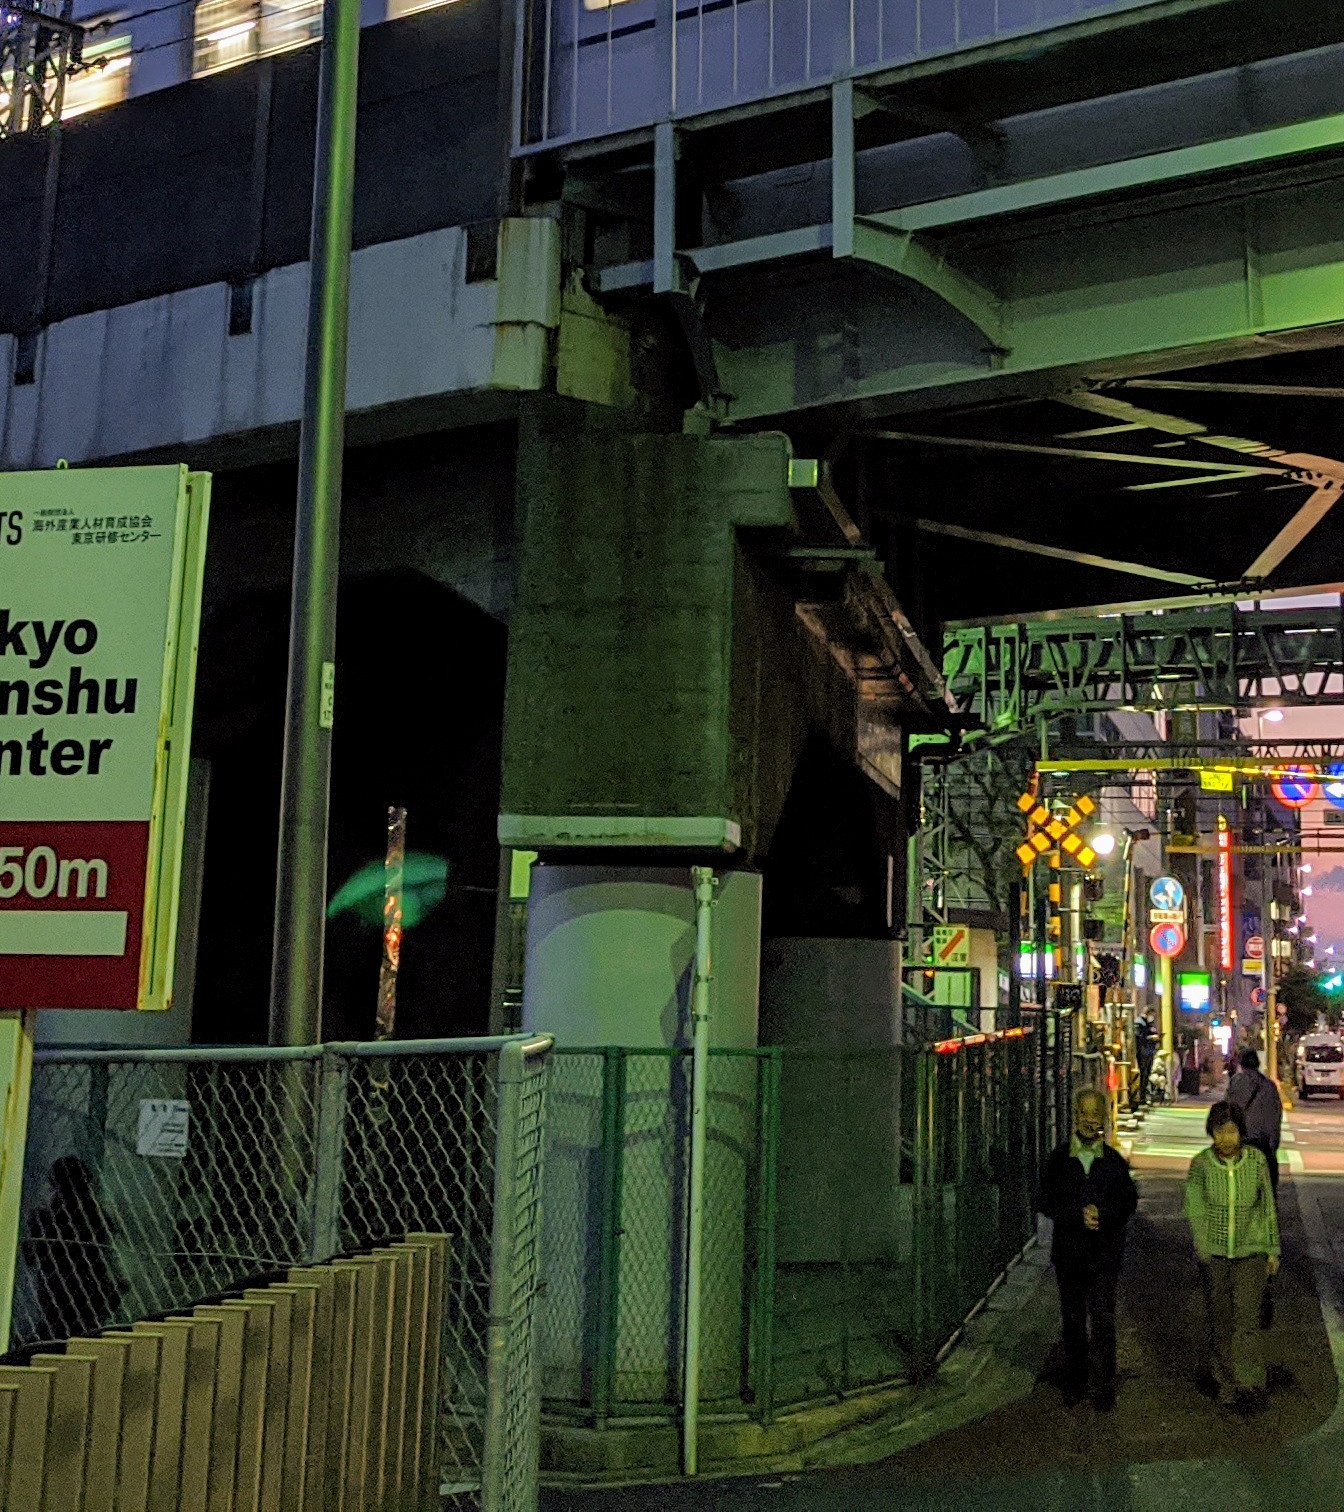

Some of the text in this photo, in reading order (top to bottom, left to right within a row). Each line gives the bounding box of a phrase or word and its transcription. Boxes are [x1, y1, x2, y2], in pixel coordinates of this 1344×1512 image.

[32, 514, 153, 532] 海外産業人材育成協会
[71, 531, 162, 545] 東京研修センター
